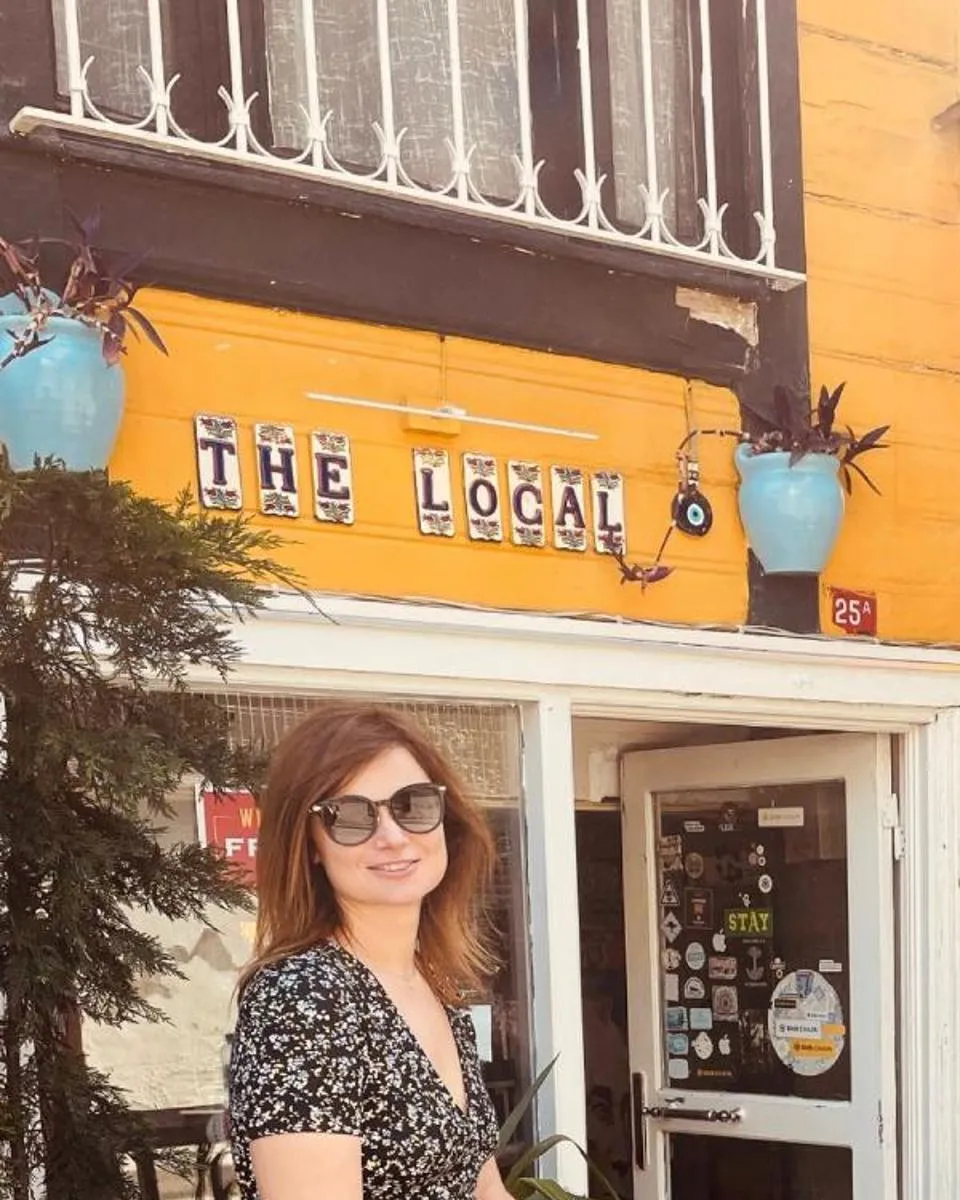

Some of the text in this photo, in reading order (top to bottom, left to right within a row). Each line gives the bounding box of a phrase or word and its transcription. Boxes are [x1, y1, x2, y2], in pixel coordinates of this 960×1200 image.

[200, 438, 624, 533] THE LOCAL
[728, 911, 769, 933] STAY
